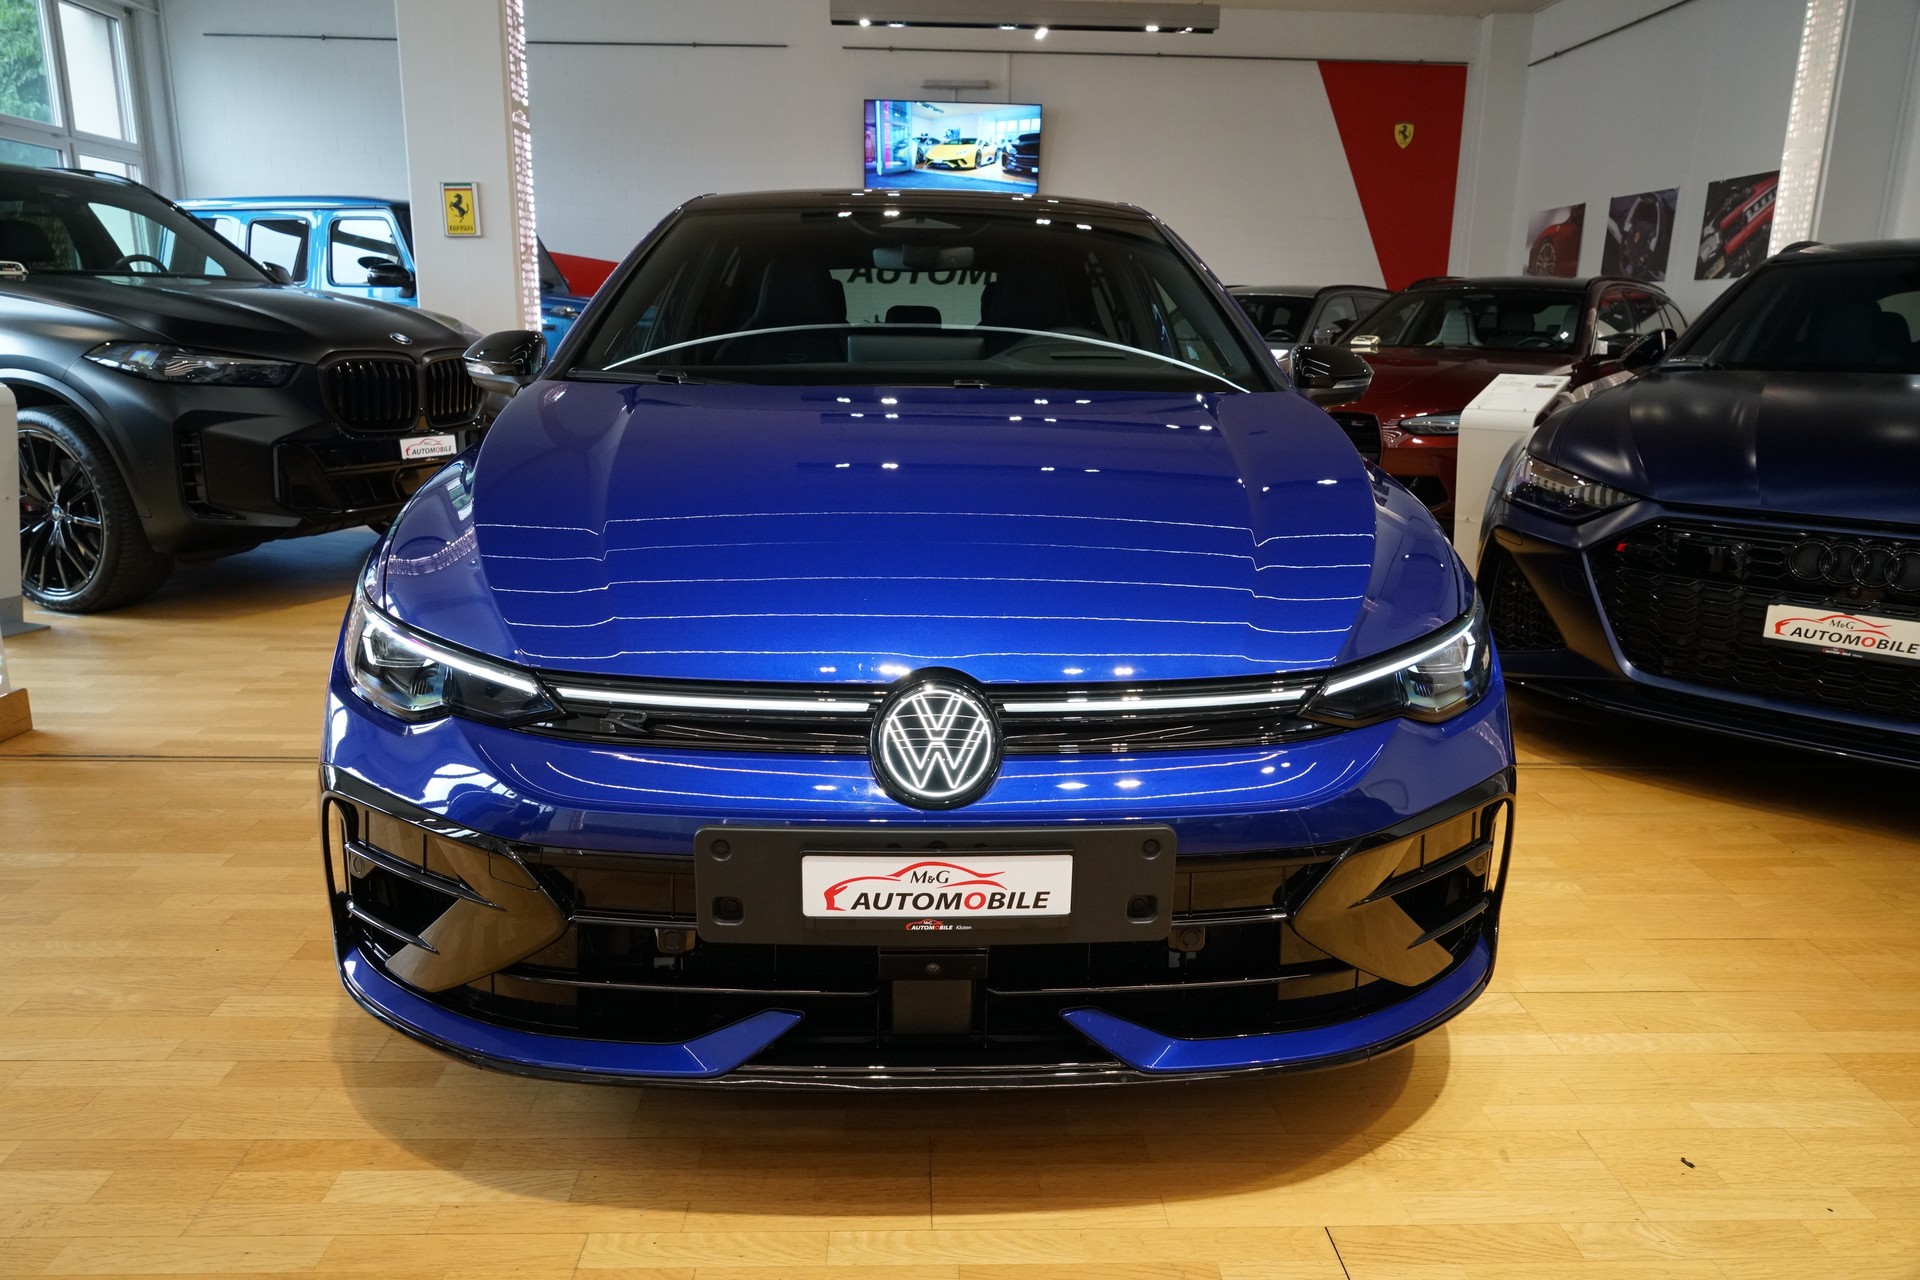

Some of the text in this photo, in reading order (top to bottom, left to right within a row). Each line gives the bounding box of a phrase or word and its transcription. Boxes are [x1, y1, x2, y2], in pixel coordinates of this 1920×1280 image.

[411, 445, 453, 456] AUTOMOBILE
[1829, 619, 1856, 630] M&G
[1790, 627, 1920, 655] AUTOMOBILE
[910, 870, 951, 885] M&G
[851, 890, 1051, 911] AUTOMOBILE
